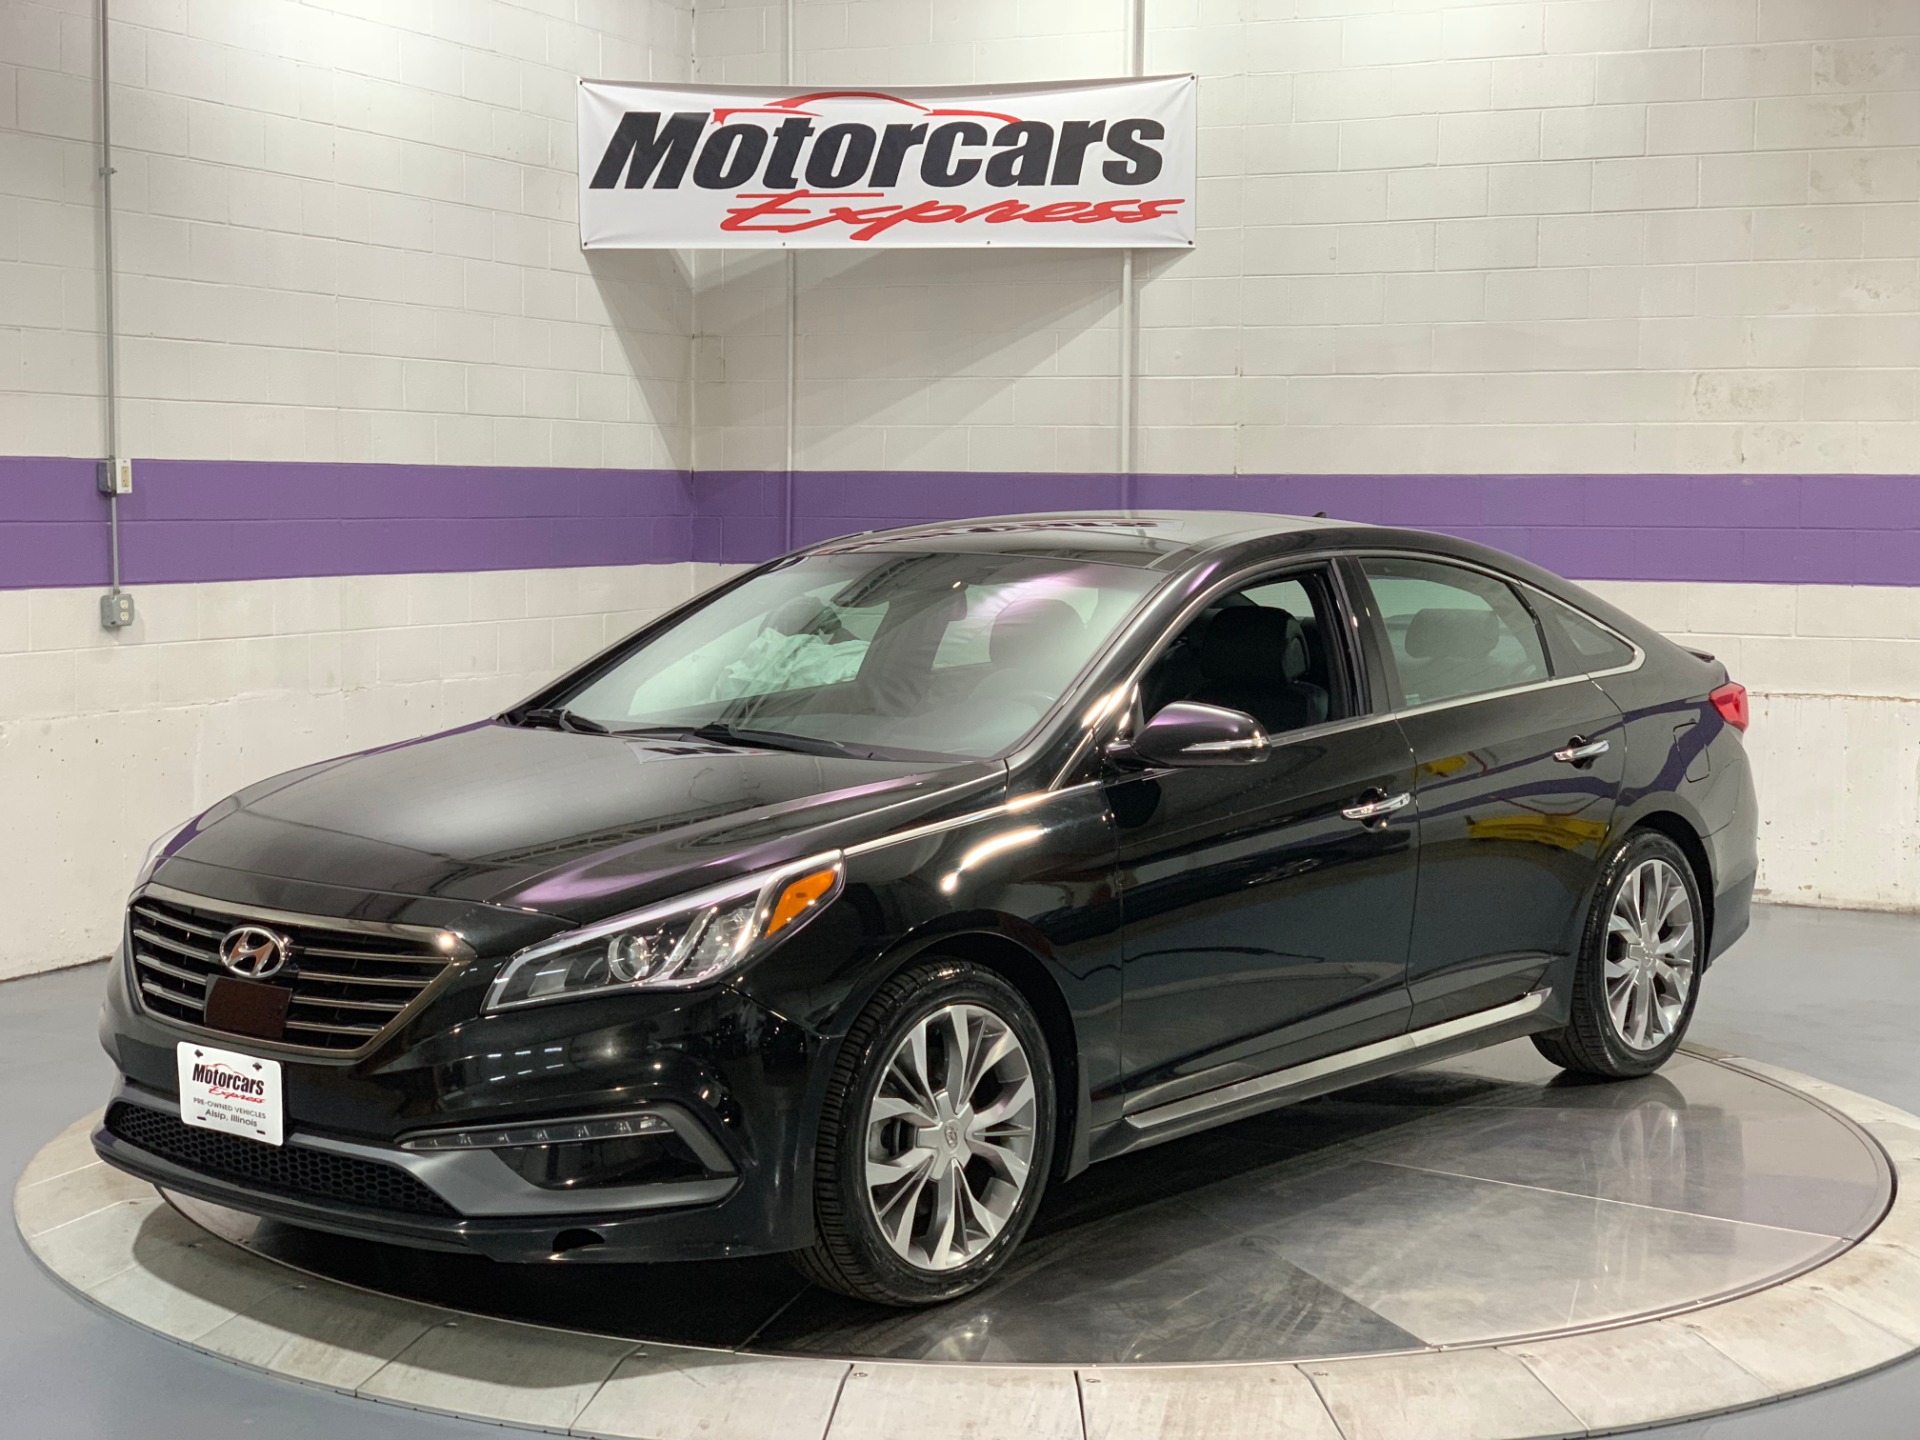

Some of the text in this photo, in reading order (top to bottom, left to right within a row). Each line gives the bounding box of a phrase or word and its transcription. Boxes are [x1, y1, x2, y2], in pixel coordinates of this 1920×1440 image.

[589, 111, 1165, 190] Motorcars
[720, 190, 1186, 241] Express
[192, 1063, 264, 1096] Motorcars
[193, 1097, 267, 1120] PRE-OWNED VEHICLES
[208, 1086, 266, 1104] Express
[205, 1109, 258, 1128] Alsip, Illinois
